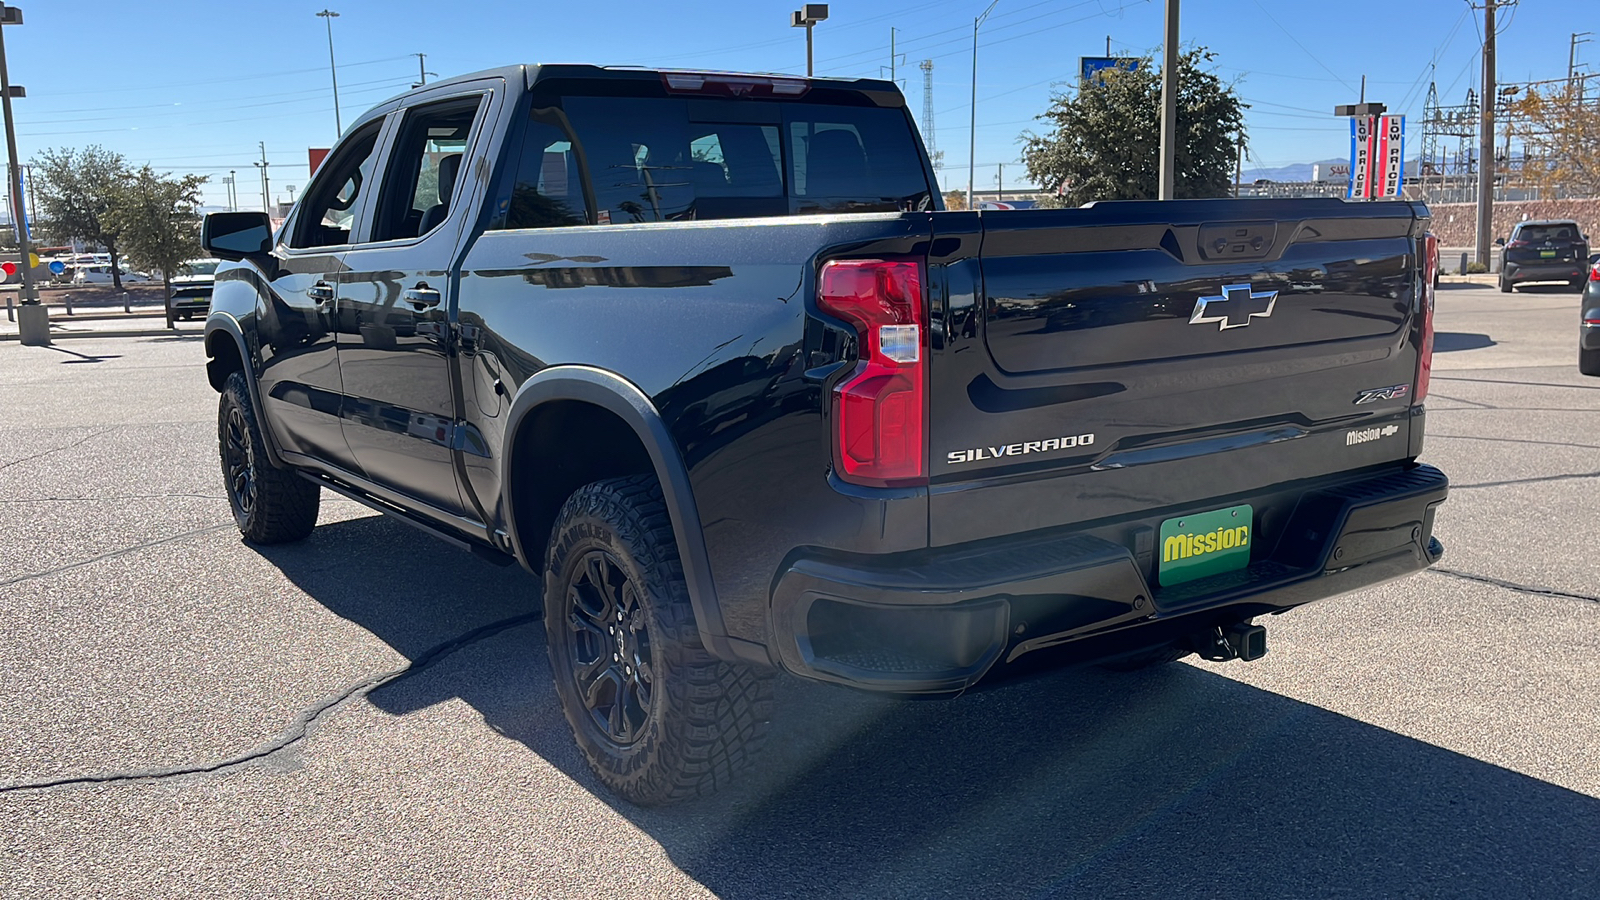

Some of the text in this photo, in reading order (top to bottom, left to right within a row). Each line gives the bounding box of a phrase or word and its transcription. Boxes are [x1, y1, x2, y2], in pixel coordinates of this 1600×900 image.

[1355, 120, 1367, 196] LOW PRICES
[1387, 118, 1400, 195] LOW PRICES
[1353, 384, 1410, 405] ZR2
[947, 433, 1095, 464] SILVERADO
[1346, 427, 1381, 446] Mission
[549, 521, 613, 578] WRANGLER
[1163, 525, 1248, 563] Mission
